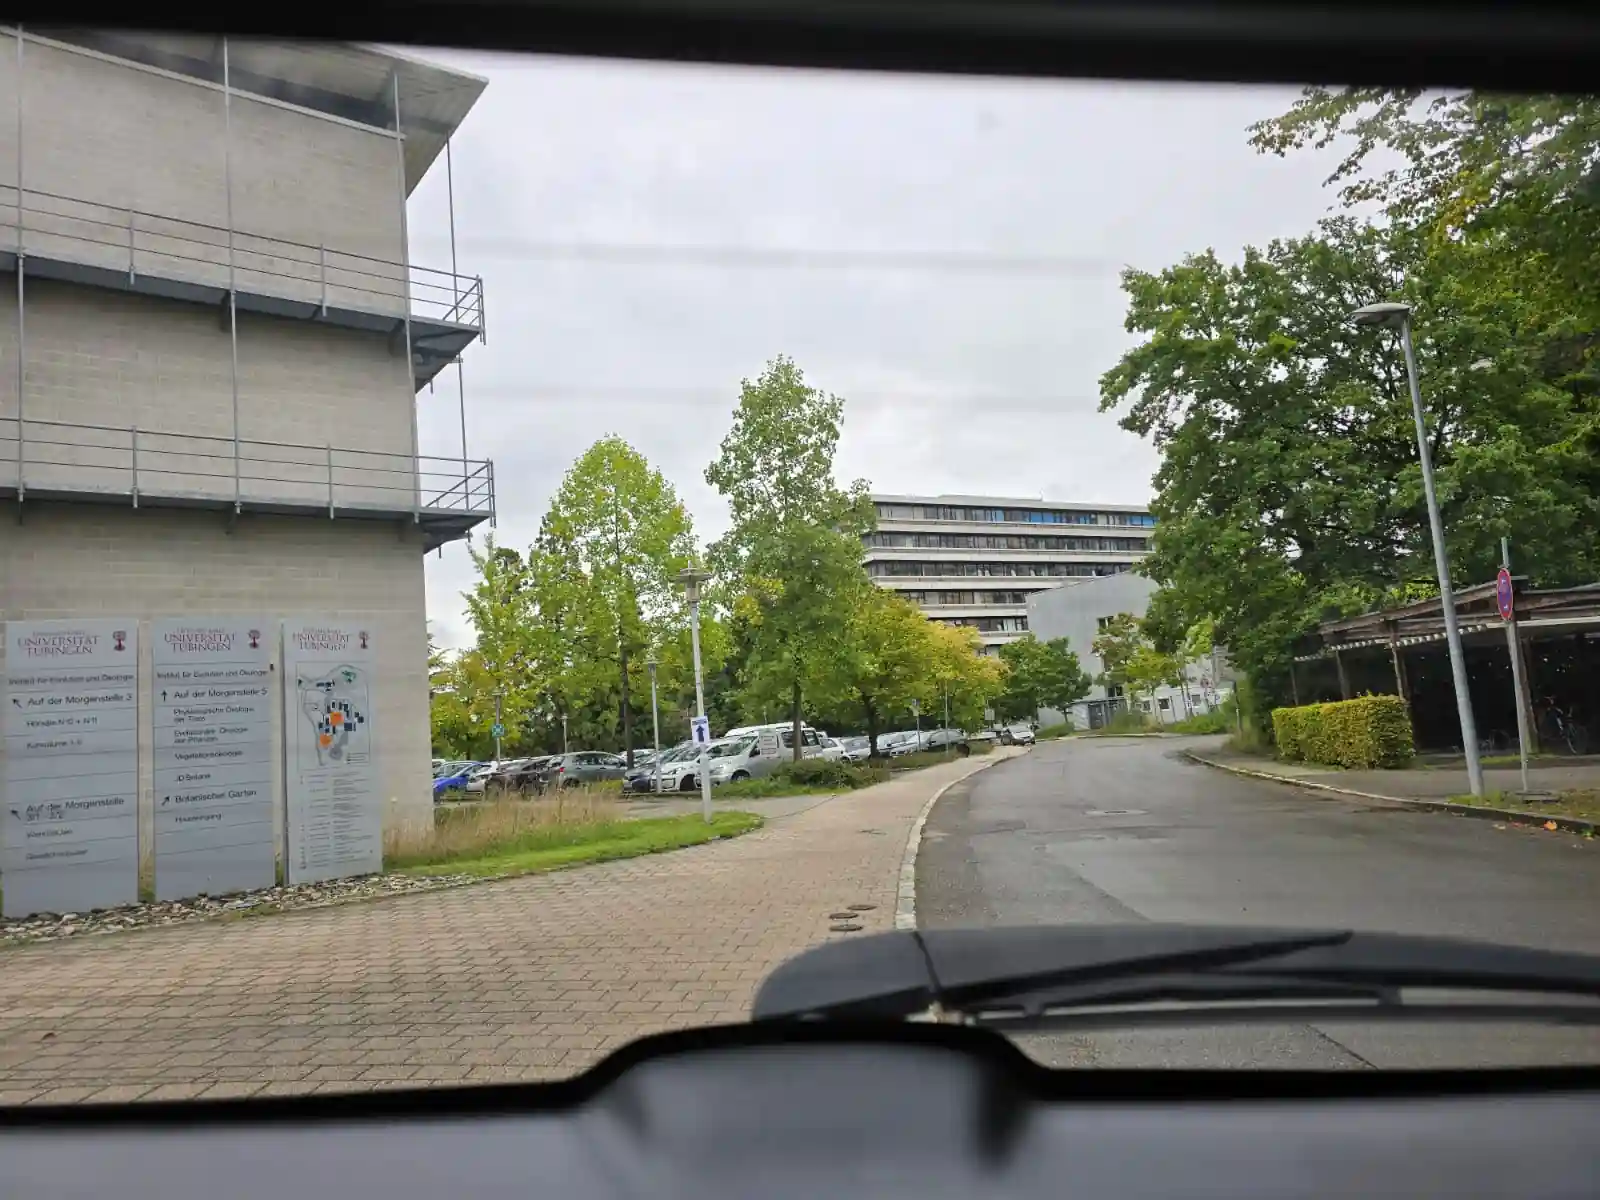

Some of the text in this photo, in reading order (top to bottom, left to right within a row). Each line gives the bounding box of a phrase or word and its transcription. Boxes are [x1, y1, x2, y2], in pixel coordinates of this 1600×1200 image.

[174, 689, 189, 699] Auf
[192, 689, 206, 698] der
[28, 697, 44, 706] Auf
[47, 696, 62, 705] der
